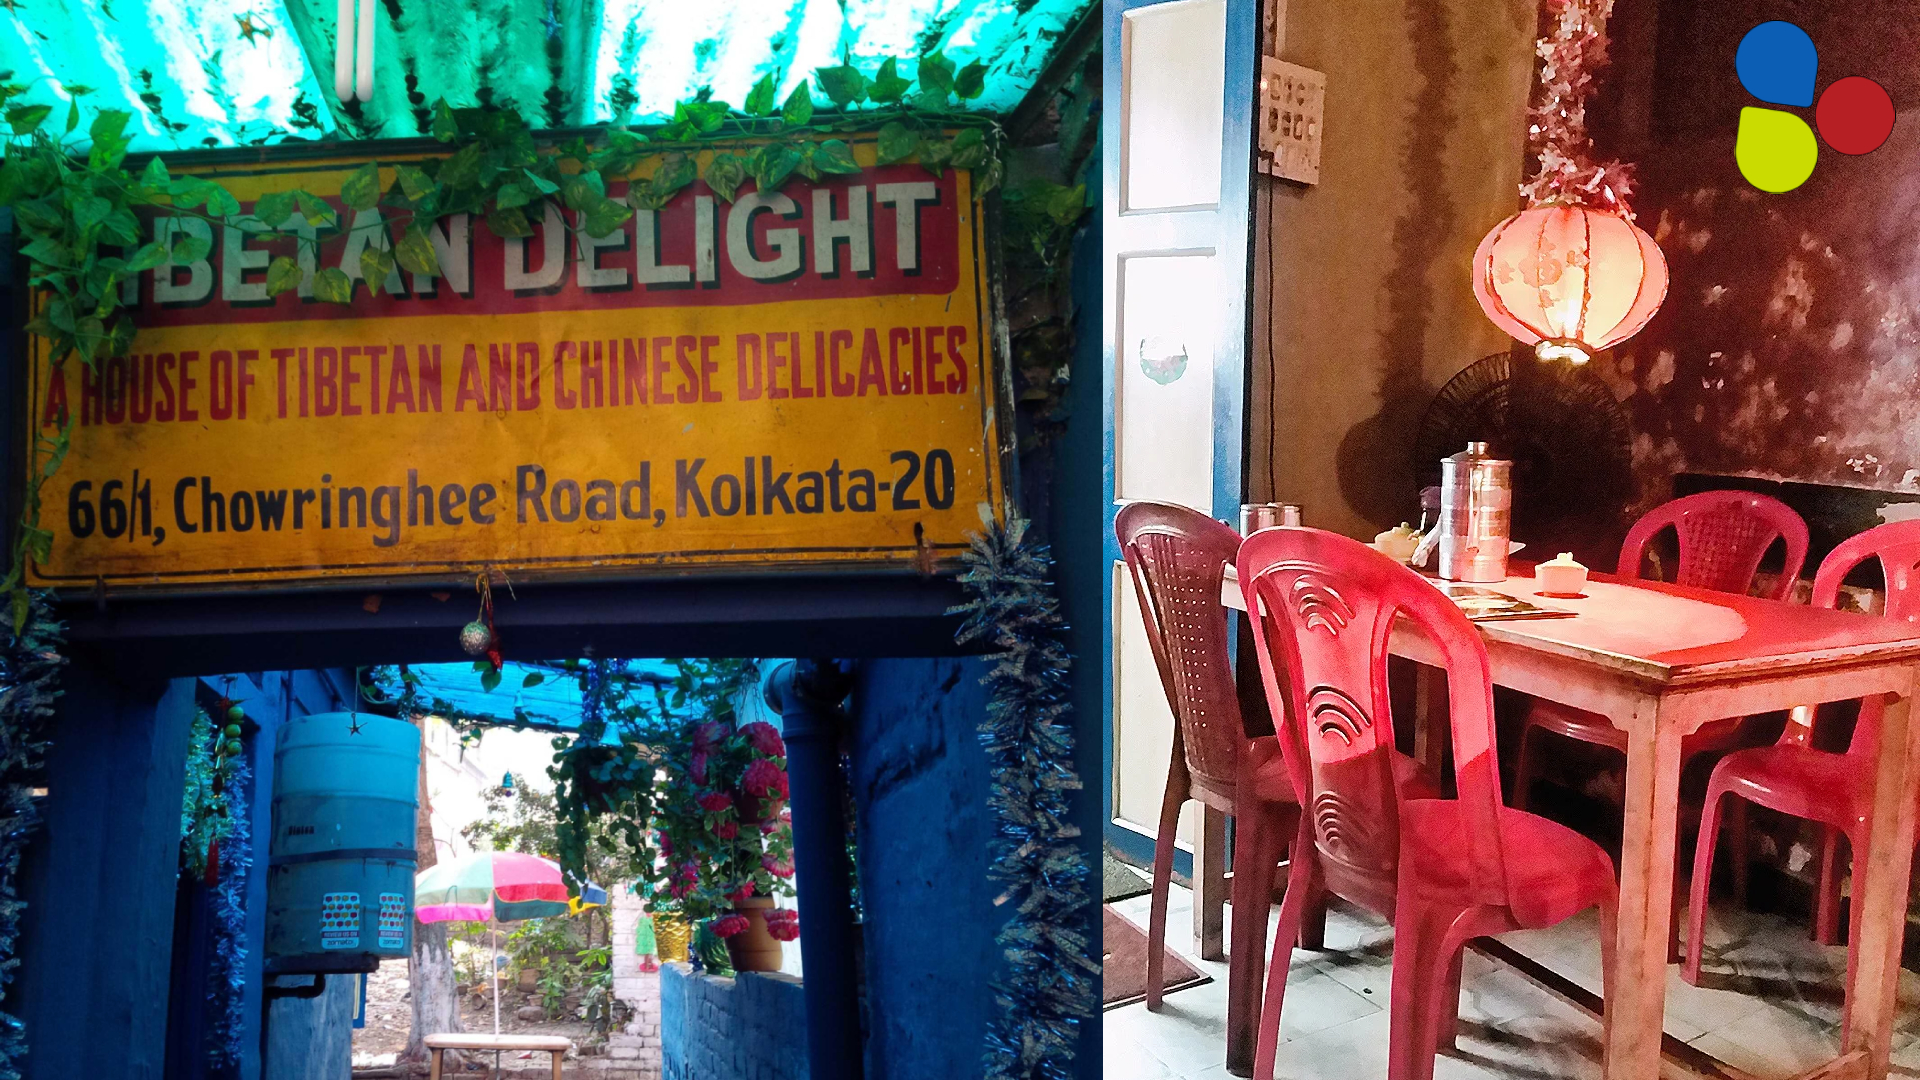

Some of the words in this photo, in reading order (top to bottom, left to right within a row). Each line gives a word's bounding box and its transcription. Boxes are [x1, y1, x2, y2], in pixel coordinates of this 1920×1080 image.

[80, 207, 472, 308] BETAN
[504, 181, 940, 293] DELIGHT
[43, 358, 70, 428] A
[81, 350, 200, 427] HOUSE
[209, 349, 260, 420] OF
[271, 344, 444, 419] TIBETAN
[455, 341, 541, 413] AND
[553, 335, 722, 410] CHINESE
[736, 325, 969, 402] DELICACIES
[68, 468, 166, 547] 66/1,
[173, 467, 497, 548] Chowringhee
[516, 460, 666, 528] Road,
[675, 448, 956, 518] Kolkata-20
